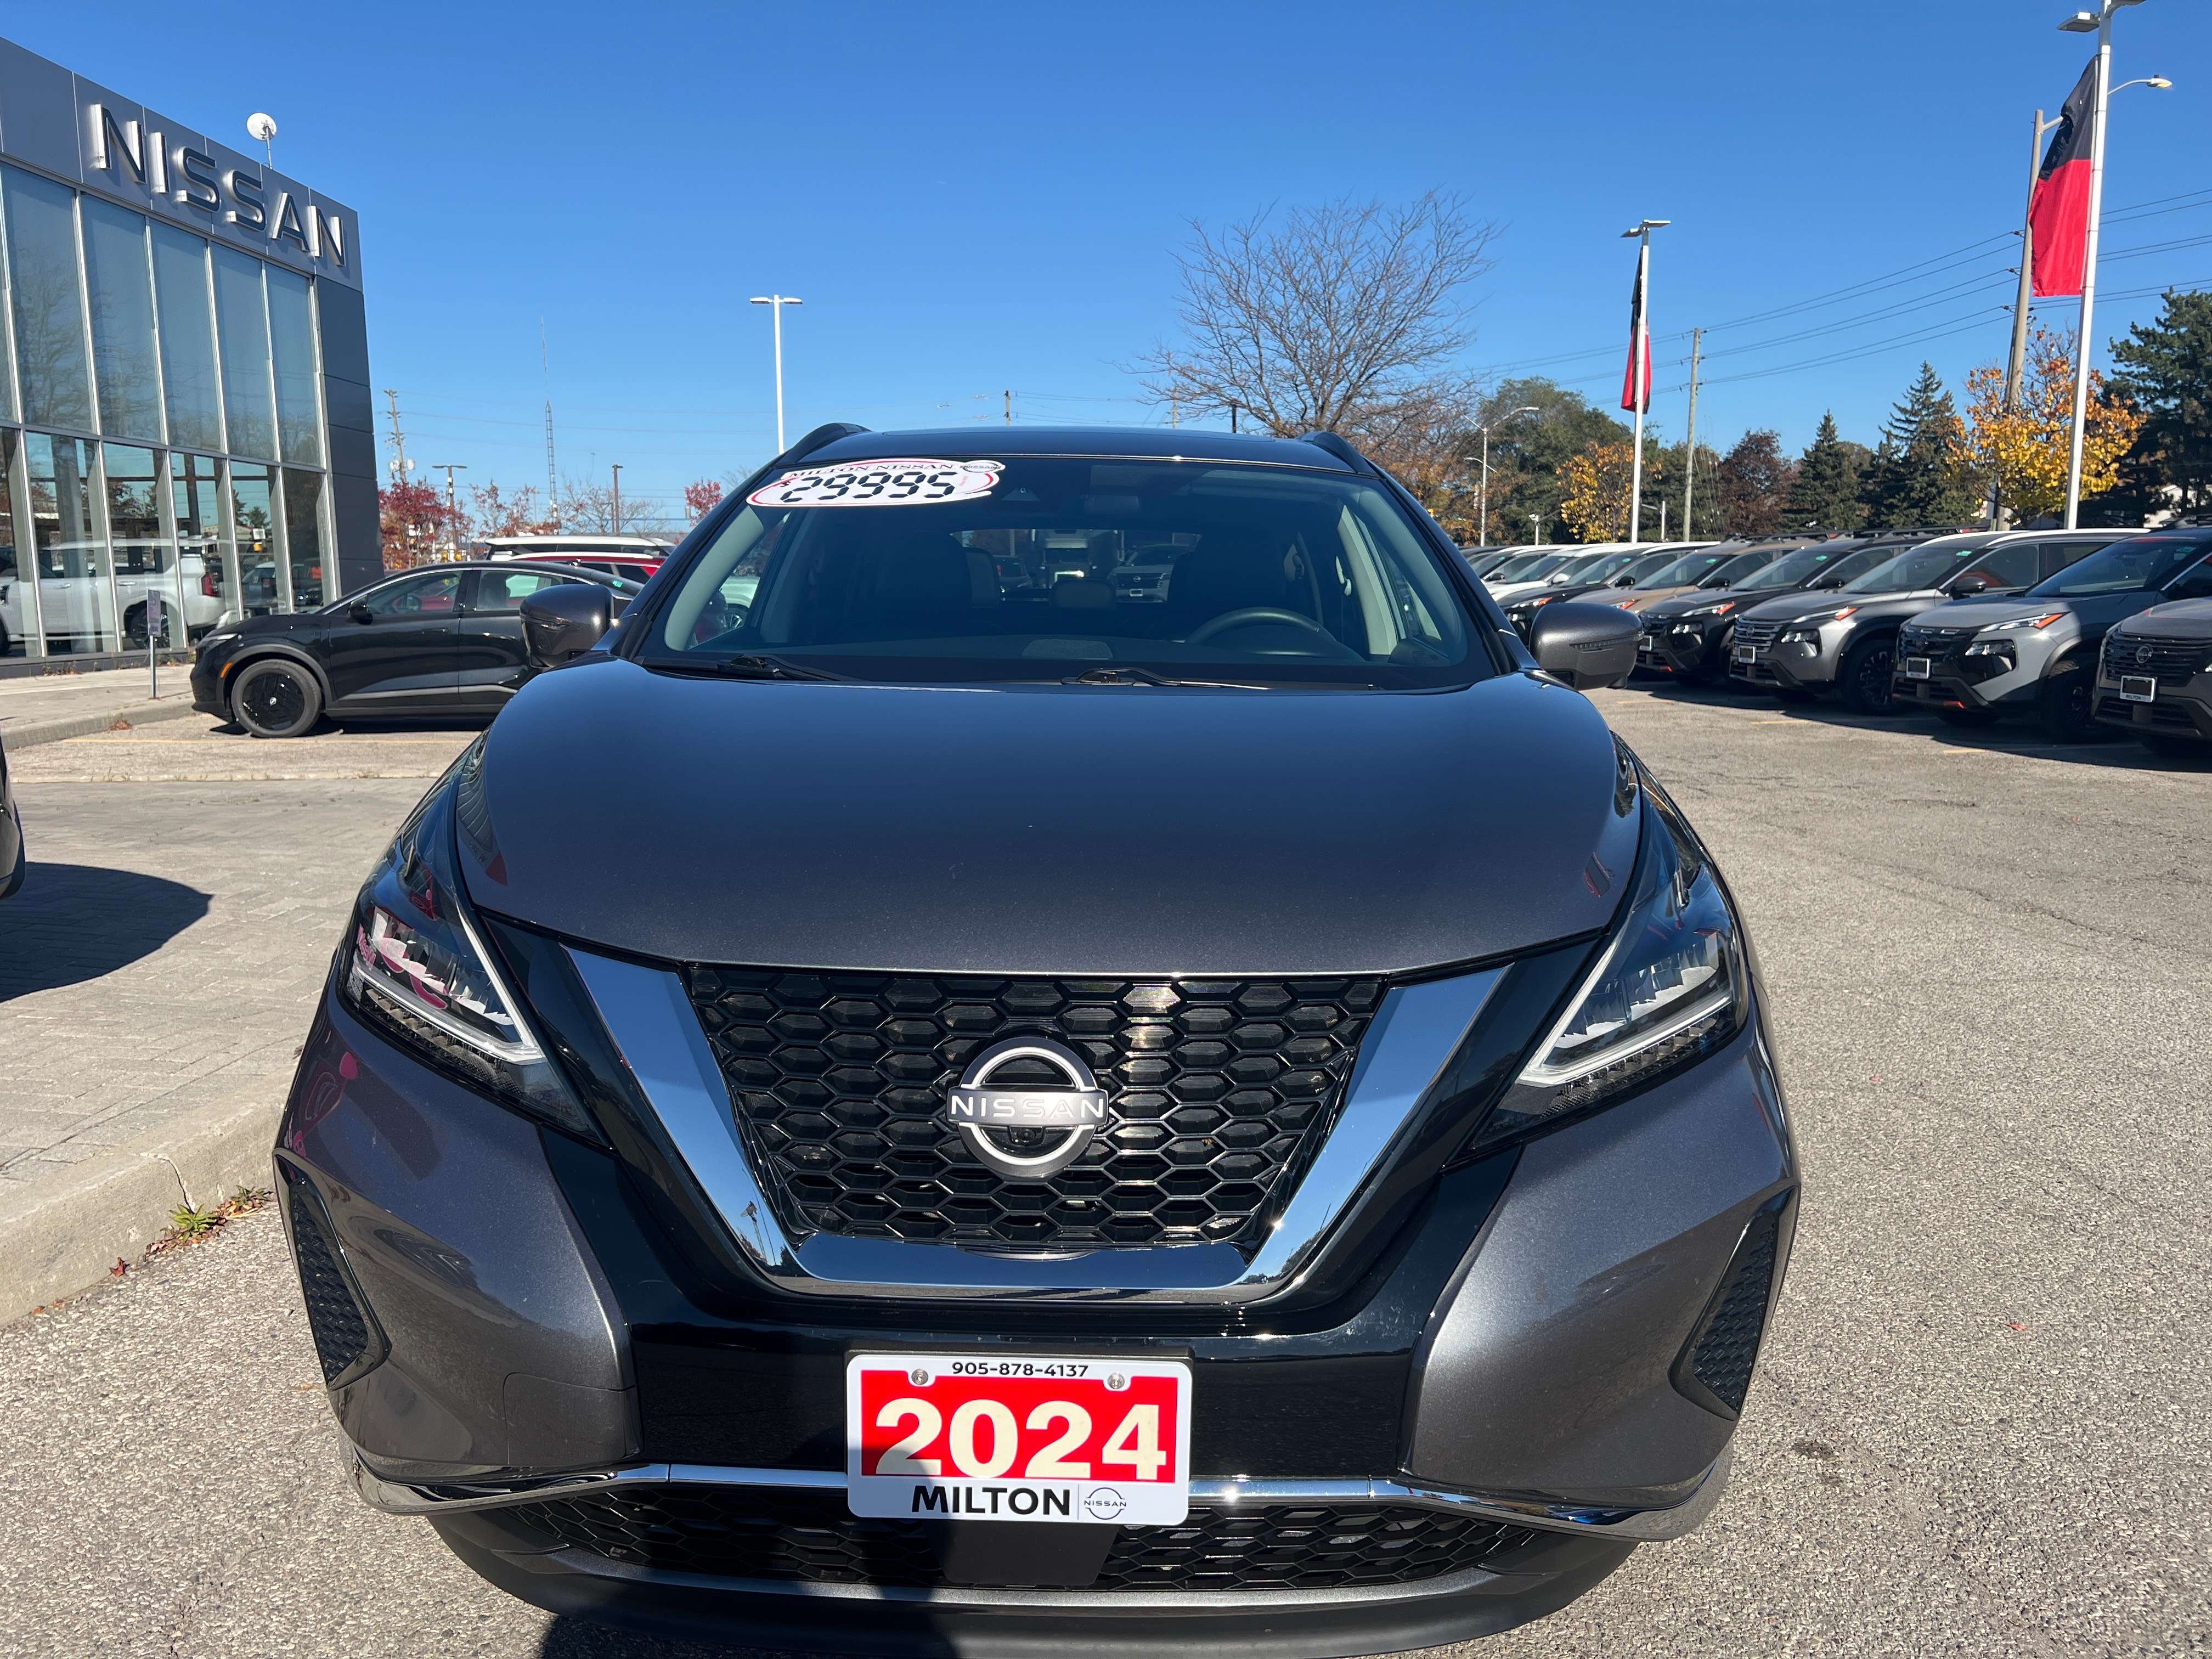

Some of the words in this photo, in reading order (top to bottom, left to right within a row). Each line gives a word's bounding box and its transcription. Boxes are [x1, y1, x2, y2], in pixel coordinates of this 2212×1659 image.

[92, 103, 346, 267] NISSAN
[791, 466, 870, 477] MILTON
[780, 472, 958, 503] 29995
[951, 1095, 1104, 1119] NISSAN
[952, 1362, 1089, 1378] 905-878-4137
[875, 1397, 1167, 1481] 2024
[911, 1485, 1070, 1516] MILTON
[1084, 1499, 1127, 1508] NISSAN
